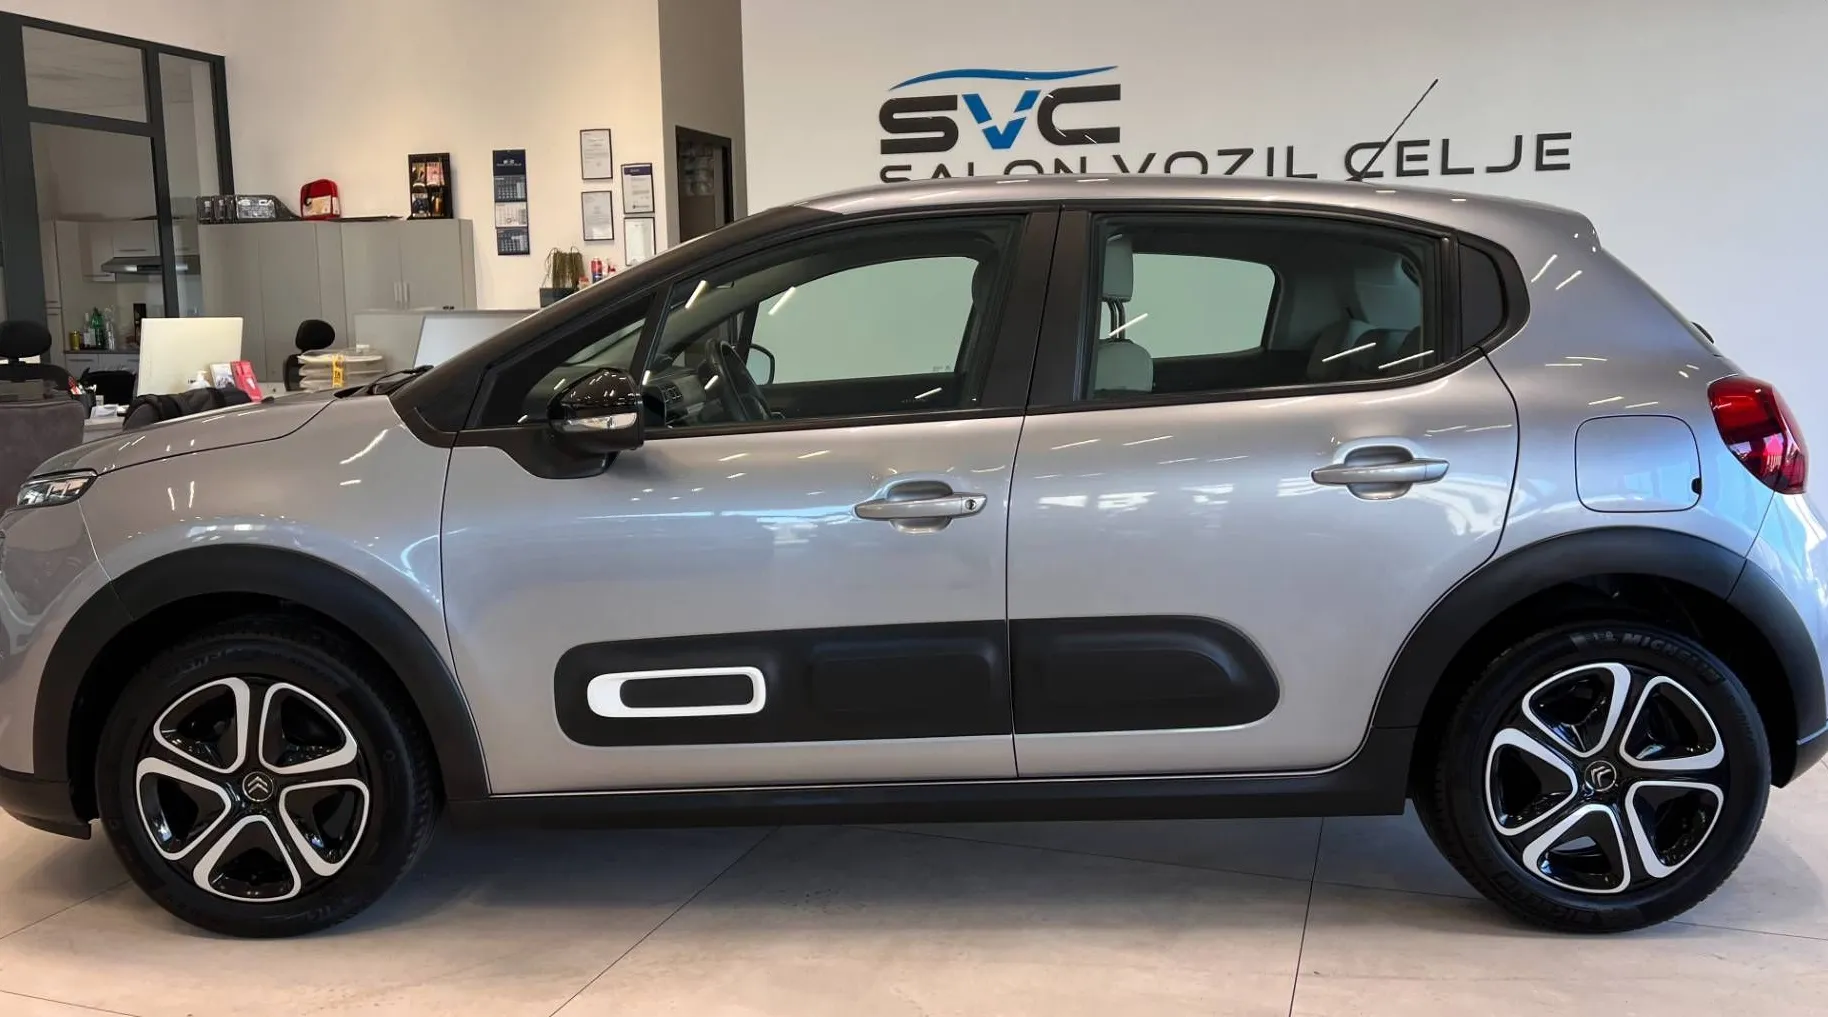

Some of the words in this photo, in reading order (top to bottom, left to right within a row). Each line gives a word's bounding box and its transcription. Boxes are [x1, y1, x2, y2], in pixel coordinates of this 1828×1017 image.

[879, 84, 1121, 154] SVC
[1112, 145, 1318, 179] VOZIL
[1344, 132, 1572, 178] CELJE
